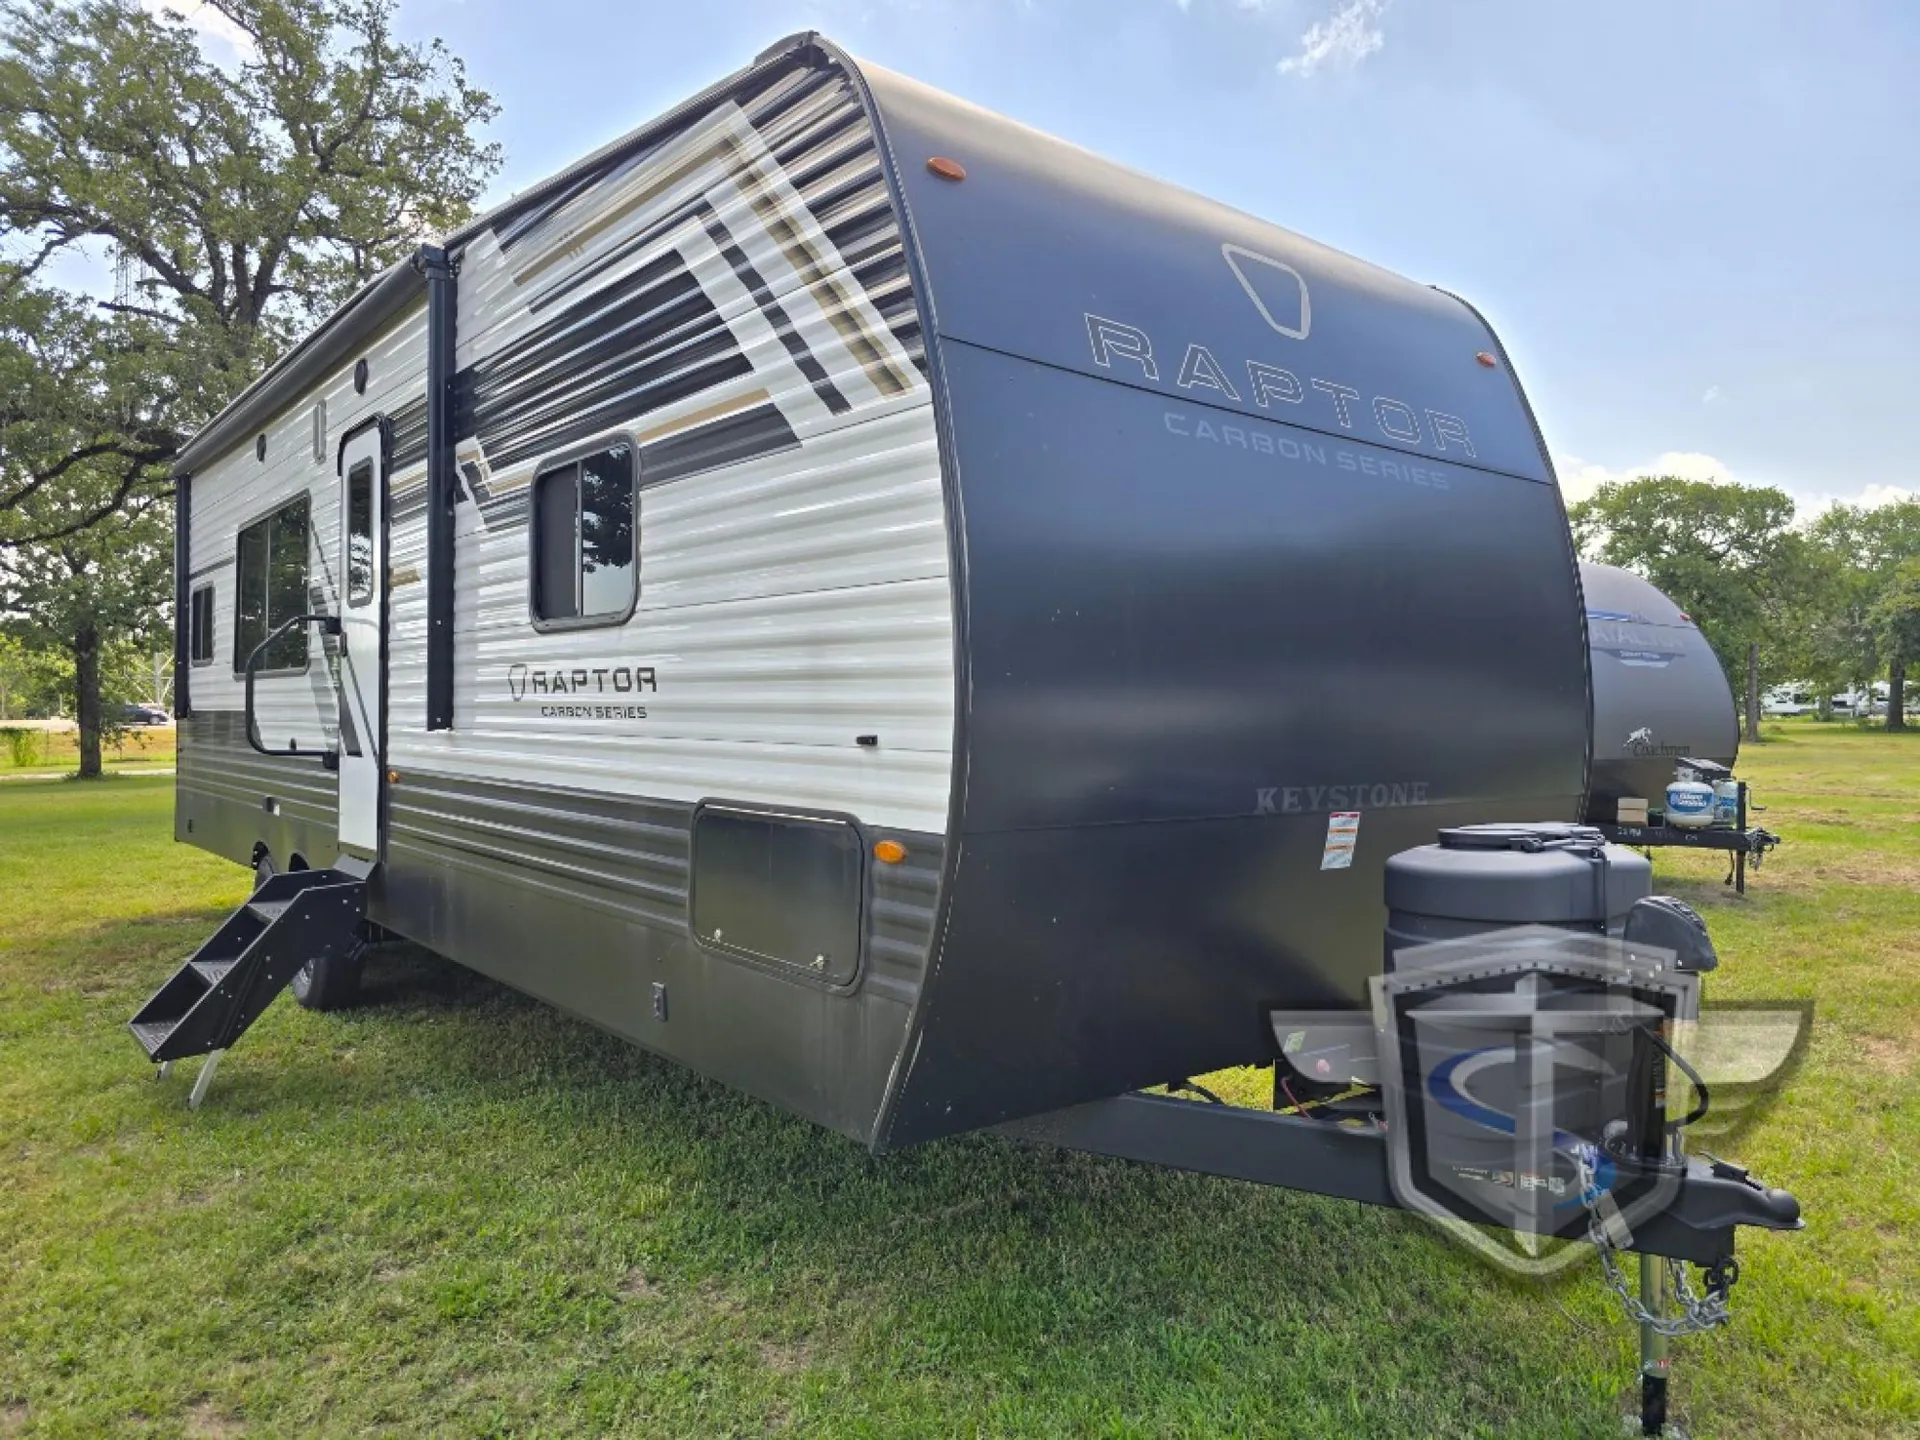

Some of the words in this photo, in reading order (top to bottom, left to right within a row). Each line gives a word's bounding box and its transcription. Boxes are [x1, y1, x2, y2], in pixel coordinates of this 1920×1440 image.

[1083, 311, 1477, 459] RAPTOR
[1163, 411, 1327, 467] CARBON
[1335, 450, 1451, 491] SERIES
[532, 666, 657, 694] RAPTOR
[541, 706, 592, 718] CARBON
[595, 706, 648, 719] SERIES
[1253, 781, 1430, 815] KEYSTONE
